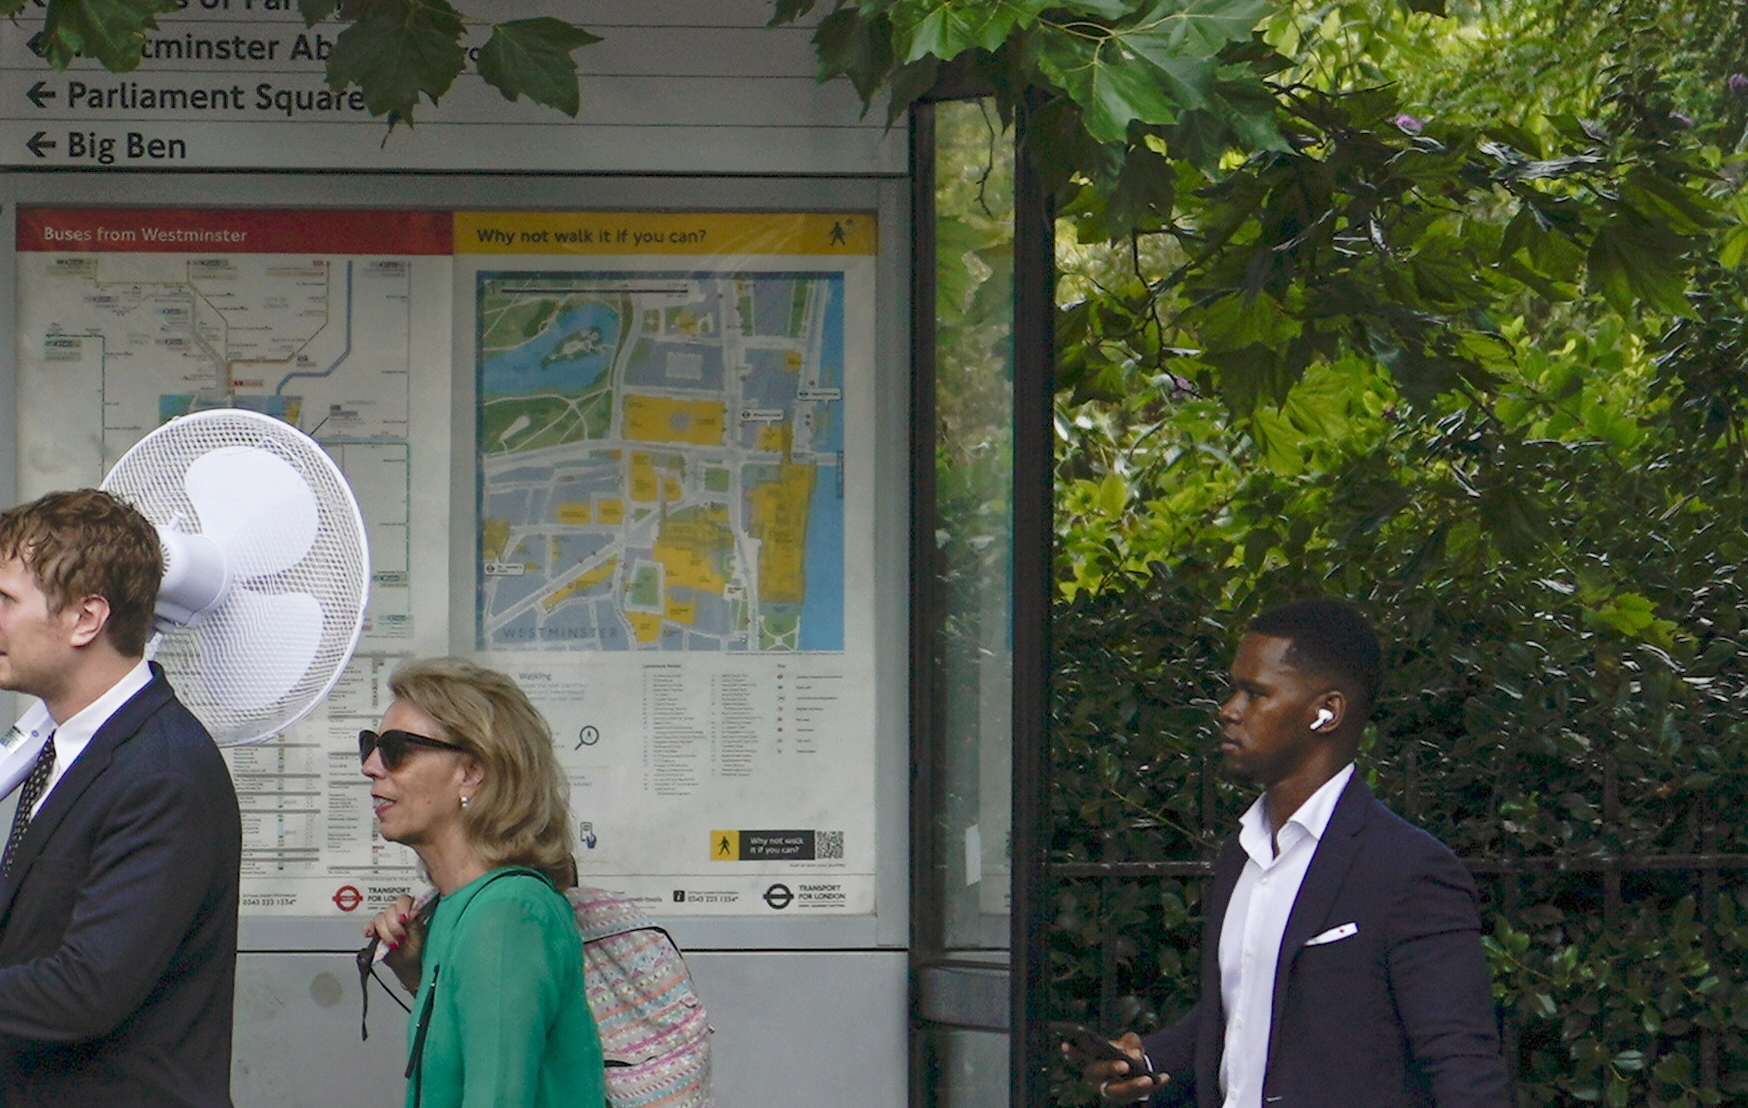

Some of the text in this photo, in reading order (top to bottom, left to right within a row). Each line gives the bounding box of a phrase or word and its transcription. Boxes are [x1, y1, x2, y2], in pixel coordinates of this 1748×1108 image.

[68, 81, 366, 117] Parliament Square
[68, 131, 186, 164] Big Ben
[43, 226, 248, 243] Buses from Westminster
[476, 229, 707, 247] Why not walk it if you can?
[502, 627, 619, 639] WESTMINSTER
[749, 836, 768, 846] Why
[769, 837, 784, 845] not
[765, 847, 781, 855] you
